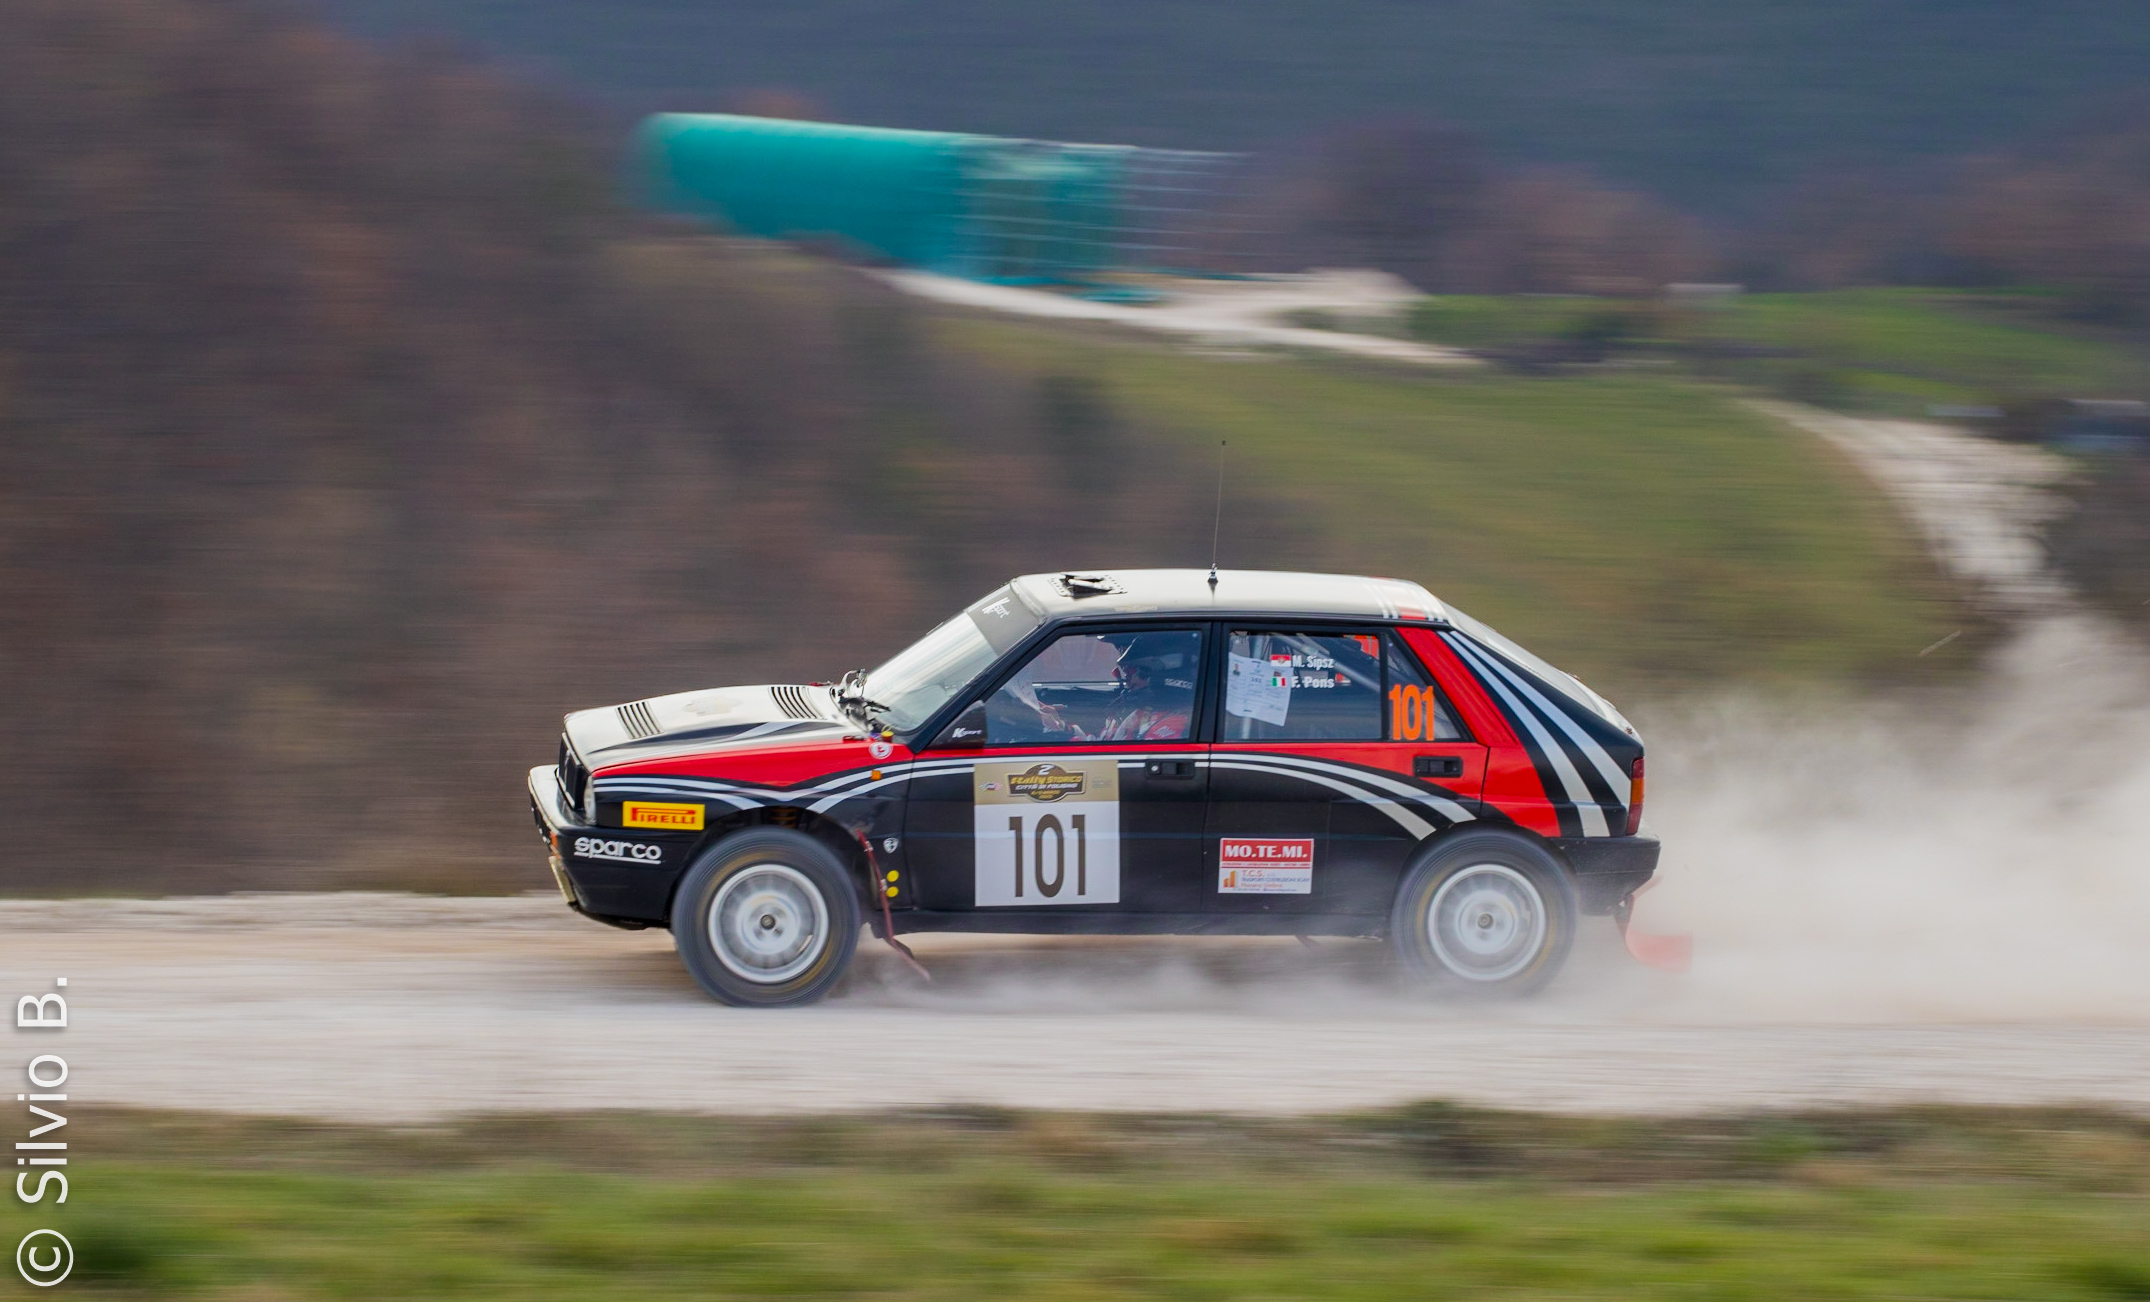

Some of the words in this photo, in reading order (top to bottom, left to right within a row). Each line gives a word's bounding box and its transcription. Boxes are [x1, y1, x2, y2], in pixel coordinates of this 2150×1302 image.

[1292, 654, 1305, 668] M.
[1307, 654, 1334, 670] Sipsz
[1291, 676, 1300, 688] F.
[1302, 676, 1335, 688] Pons
[1389, 684, 1435, 741] 101
[1038, 764, 1054, 775] 2
[631, 807, 696, 824] PIRELLI
[574, 837, 662, 860] sparco
[1009, 813, 1086, 898] 101
[1224, 845, 1308, 858] MO.TE.MI.
